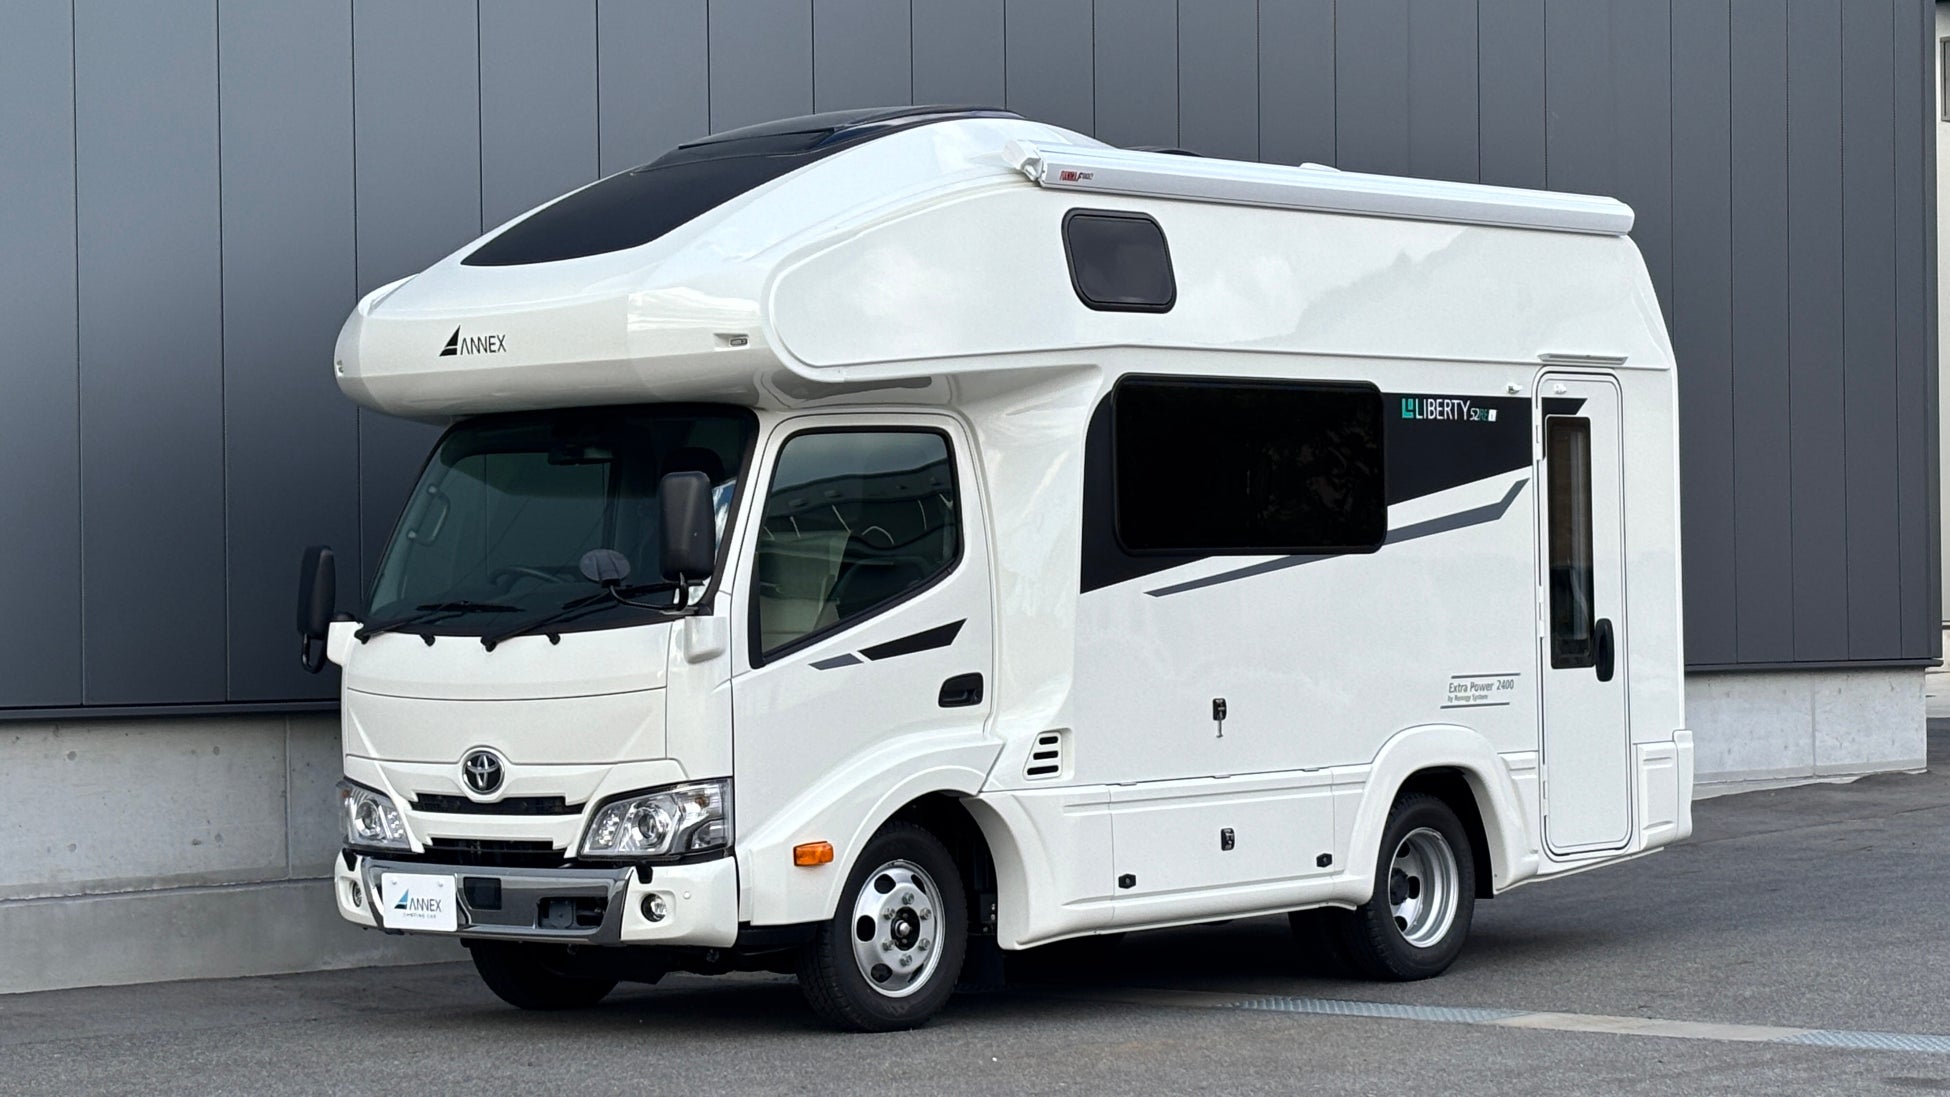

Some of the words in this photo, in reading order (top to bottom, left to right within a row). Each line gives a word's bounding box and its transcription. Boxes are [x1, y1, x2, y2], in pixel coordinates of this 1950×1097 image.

[1415, 398, 1470, 420] LIBERTY
[1448, 682, 1468, 693] Extra
[1470, 681, 1494, 692] Power
[1497, 679, 1515, 691] 2400
